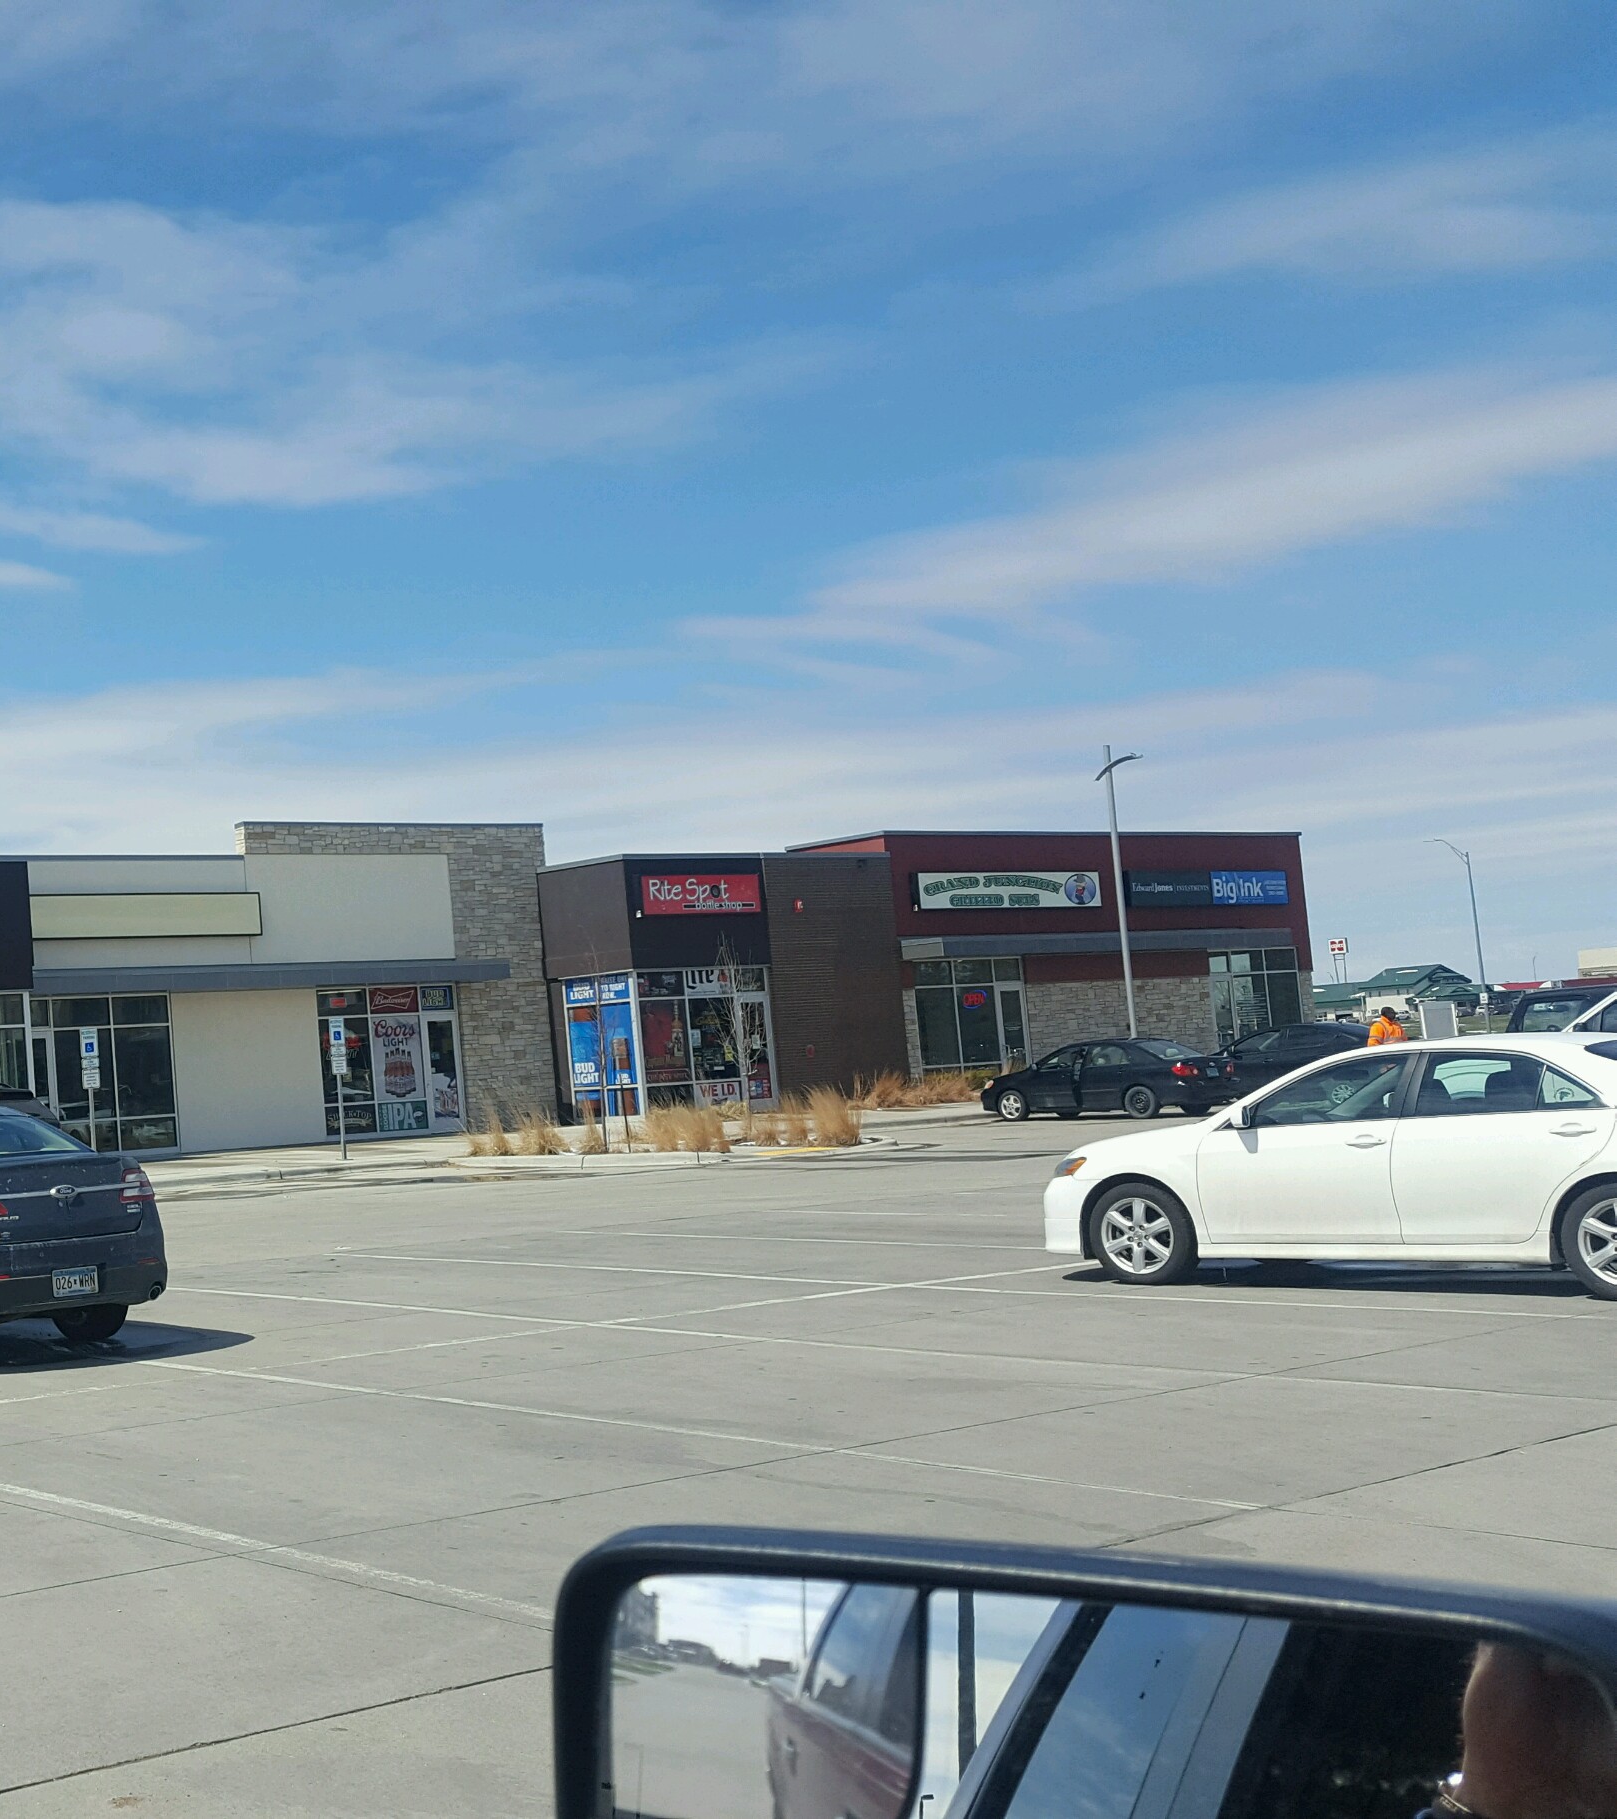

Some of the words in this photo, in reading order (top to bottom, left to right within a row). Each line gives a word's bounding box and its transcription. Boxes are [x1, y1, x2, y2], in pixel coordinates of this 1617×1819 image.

[648, 879, 682, 900] Rite
[686, 878, 729, 903] Spot
[923, 876, 980, 896] GRAND
[983, 875, 1064, 894] JUNCTION
[1212, 876, 1237, 903] Big
[1240, 877, 1263, 896] Ink
[695, 901, 719, 909] bottle
[722, 900, 743, 911] shop
[570, 989, 594, 1000] LIGHT
[963, 993, 986, 1006] OPEN
[373, 1019, 416, 1038] Coors
[383, 1038, 409, 1047] LIGHT
[574, 1062, 596, 1073] BUD
[573, 1072, 599, 1084] LIGHT
[700, 1085, 719, 1098] WE
[387, 1102, 417, 1130] IPA
[55, 1276, 72, 1290] 026
[78, 1273, 96, 1288] WRN
